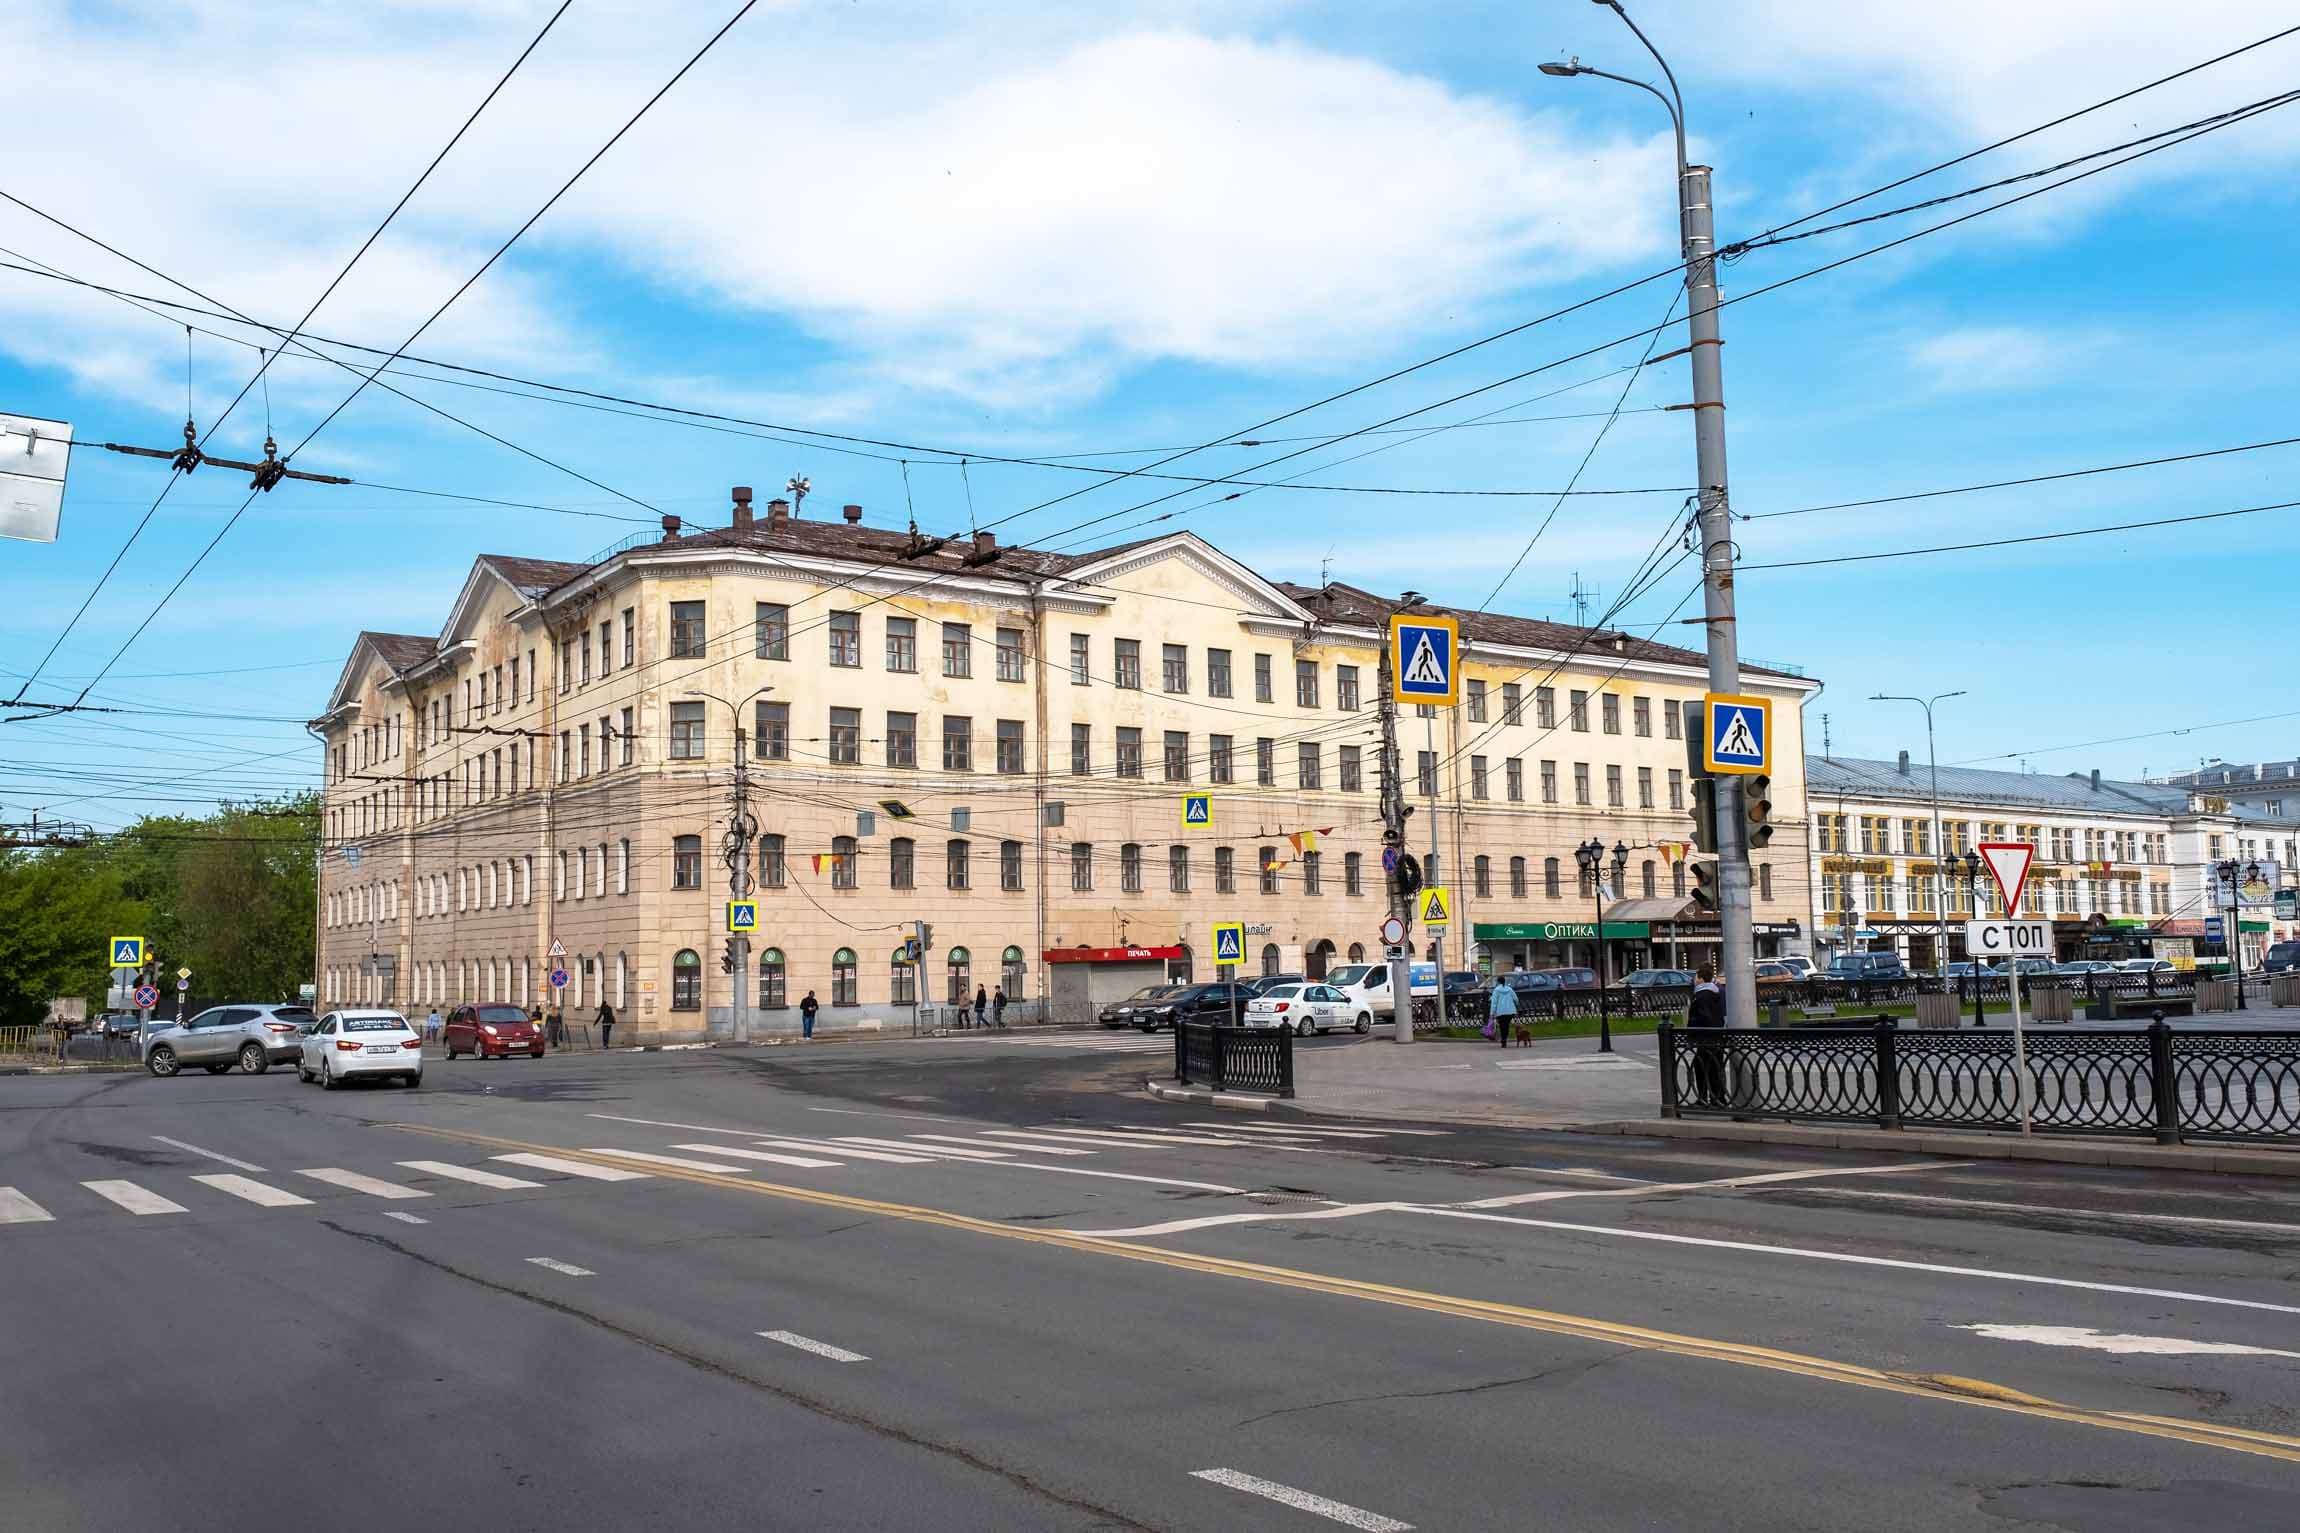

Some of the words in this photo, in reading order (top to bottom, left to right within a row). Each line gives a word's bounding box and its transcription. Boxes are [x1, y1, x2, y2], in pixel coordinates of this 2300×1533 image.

[1244, 923, 1272, 935] илайн
[1544, 923, 1596, 939] ОПТИКА
[1982, 926, 2044, 948] СТОП
[1314, 1007, 1329, 1015] Uber
